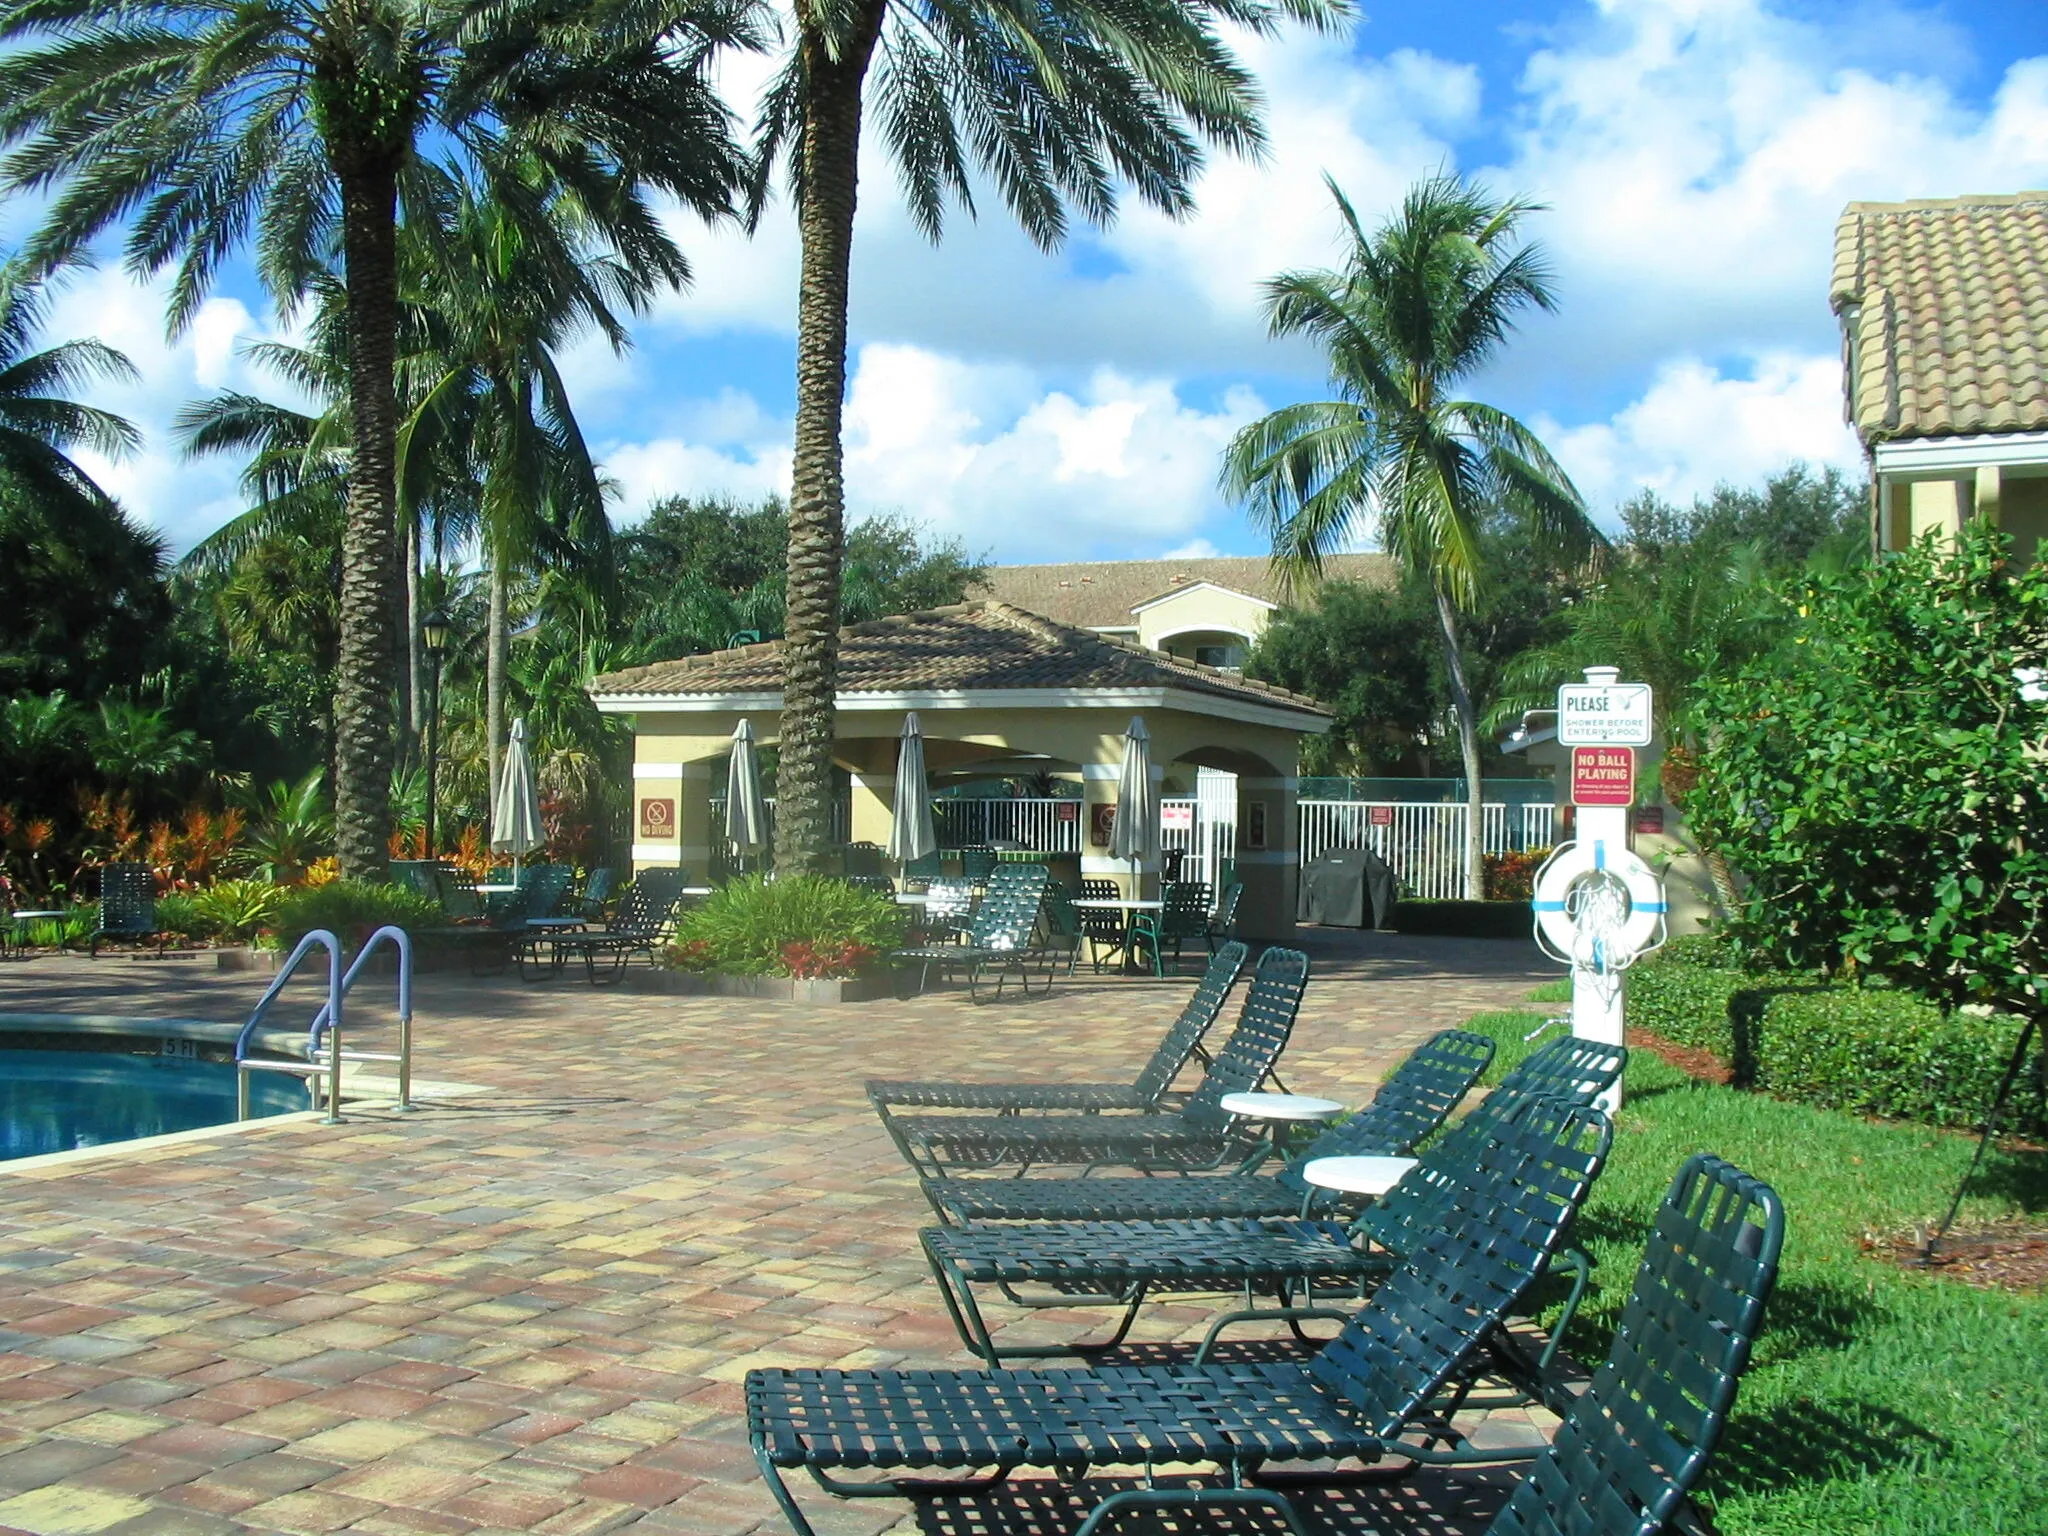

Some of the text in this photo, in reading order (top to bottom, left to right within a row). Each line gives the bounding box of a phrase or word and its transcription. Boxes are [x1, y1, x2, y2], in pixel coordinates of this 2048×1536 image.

[1567, 696, 1609, 711] PLEASE
[1566, 719, 1644, 727] SHOWER BEFORE
[1567, 728, 1642, 736] ENTERING POOL
[1578, 755, 1628, 767] NO BALL
[1578, 768, 1628, 780] PLAYING
[167, 1038, 176, 1054] 5
